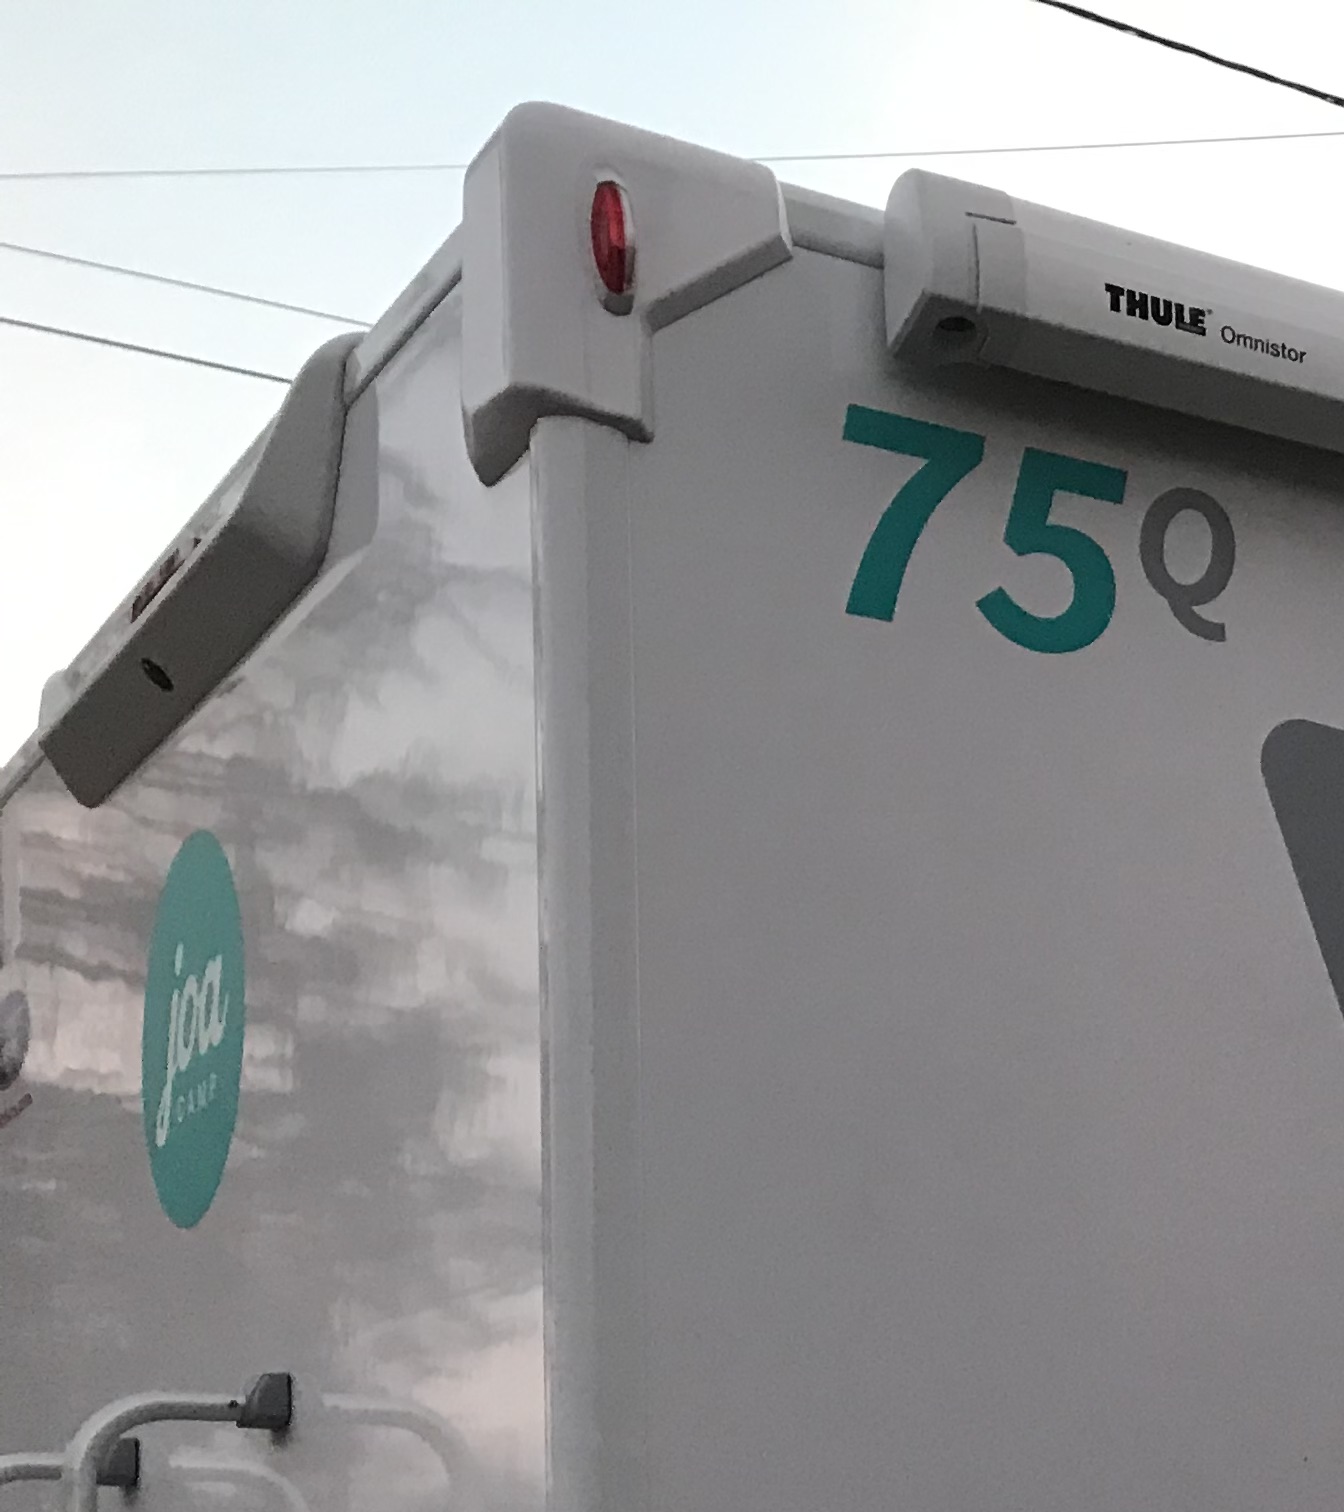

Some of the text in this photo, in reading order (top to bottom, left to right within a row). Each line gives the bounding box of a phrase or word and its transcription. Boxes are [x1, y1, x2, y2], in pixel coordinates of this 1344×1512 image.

[1105, 283, 1307, 364] THULE Omnistor
[156, 942, 229, 1147] joa
[176, 1072, 218, 1123] CAMP
